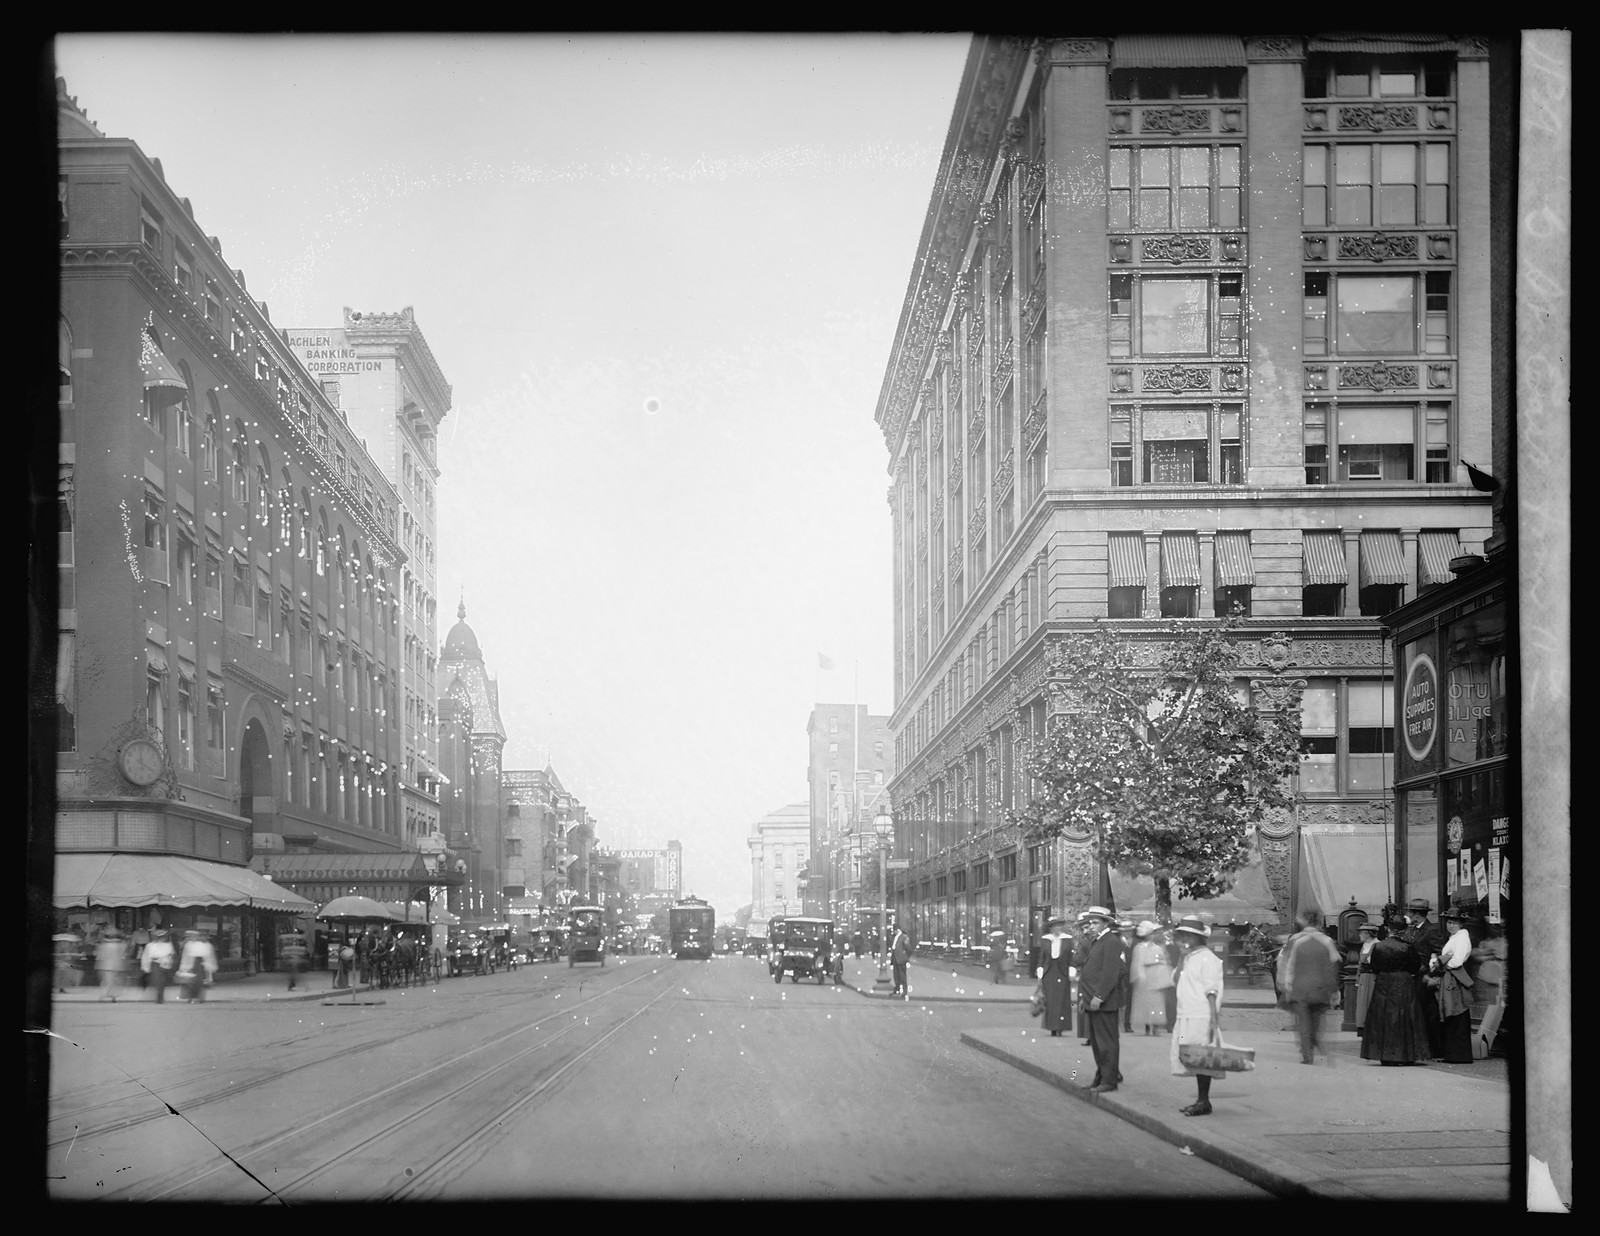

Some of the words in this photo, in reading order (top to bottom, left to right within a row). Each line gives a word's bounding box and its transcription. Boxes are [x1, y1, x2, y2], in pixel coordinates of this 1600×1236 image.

[306, 349, 356, 359] BANKING
[307, 361, 382, 372] CORPORATION
[1411, 681, 1429, 699] AUTO
[1407, 697, 1435, 719] SUPPLIES
[1409, 720, 1421, 736] FREE
[1422, 718, 1432, 732] AIR
